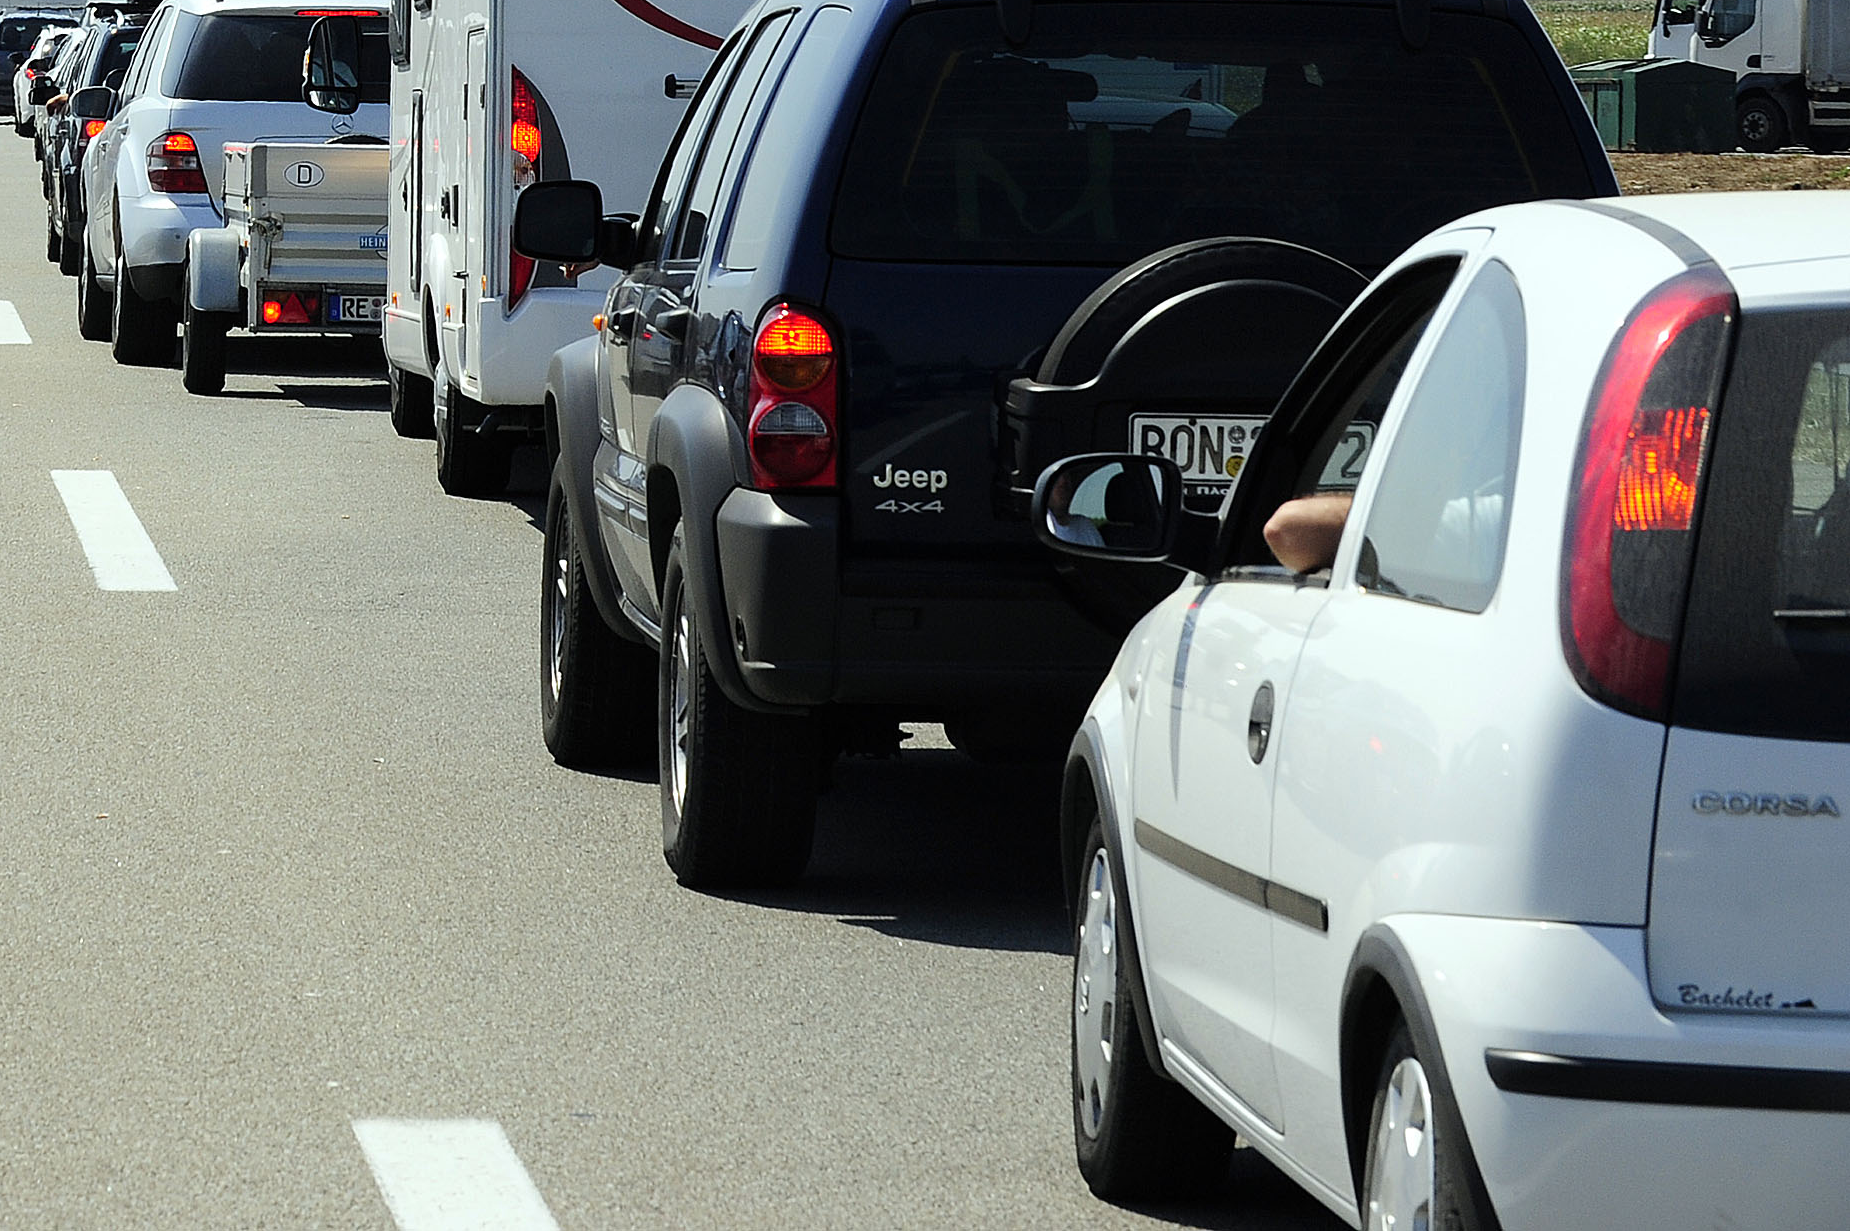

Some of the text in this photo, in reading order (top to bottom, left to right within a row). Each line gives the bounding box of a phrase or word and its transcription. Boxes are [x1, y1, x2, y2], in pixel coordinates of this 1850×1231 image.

[297, 164, 312, 184] D
[341, 297, 369, 319] RE
[873, 463, 948, 494] Jeep
[1692, 789, 1841, 818] CORSA
